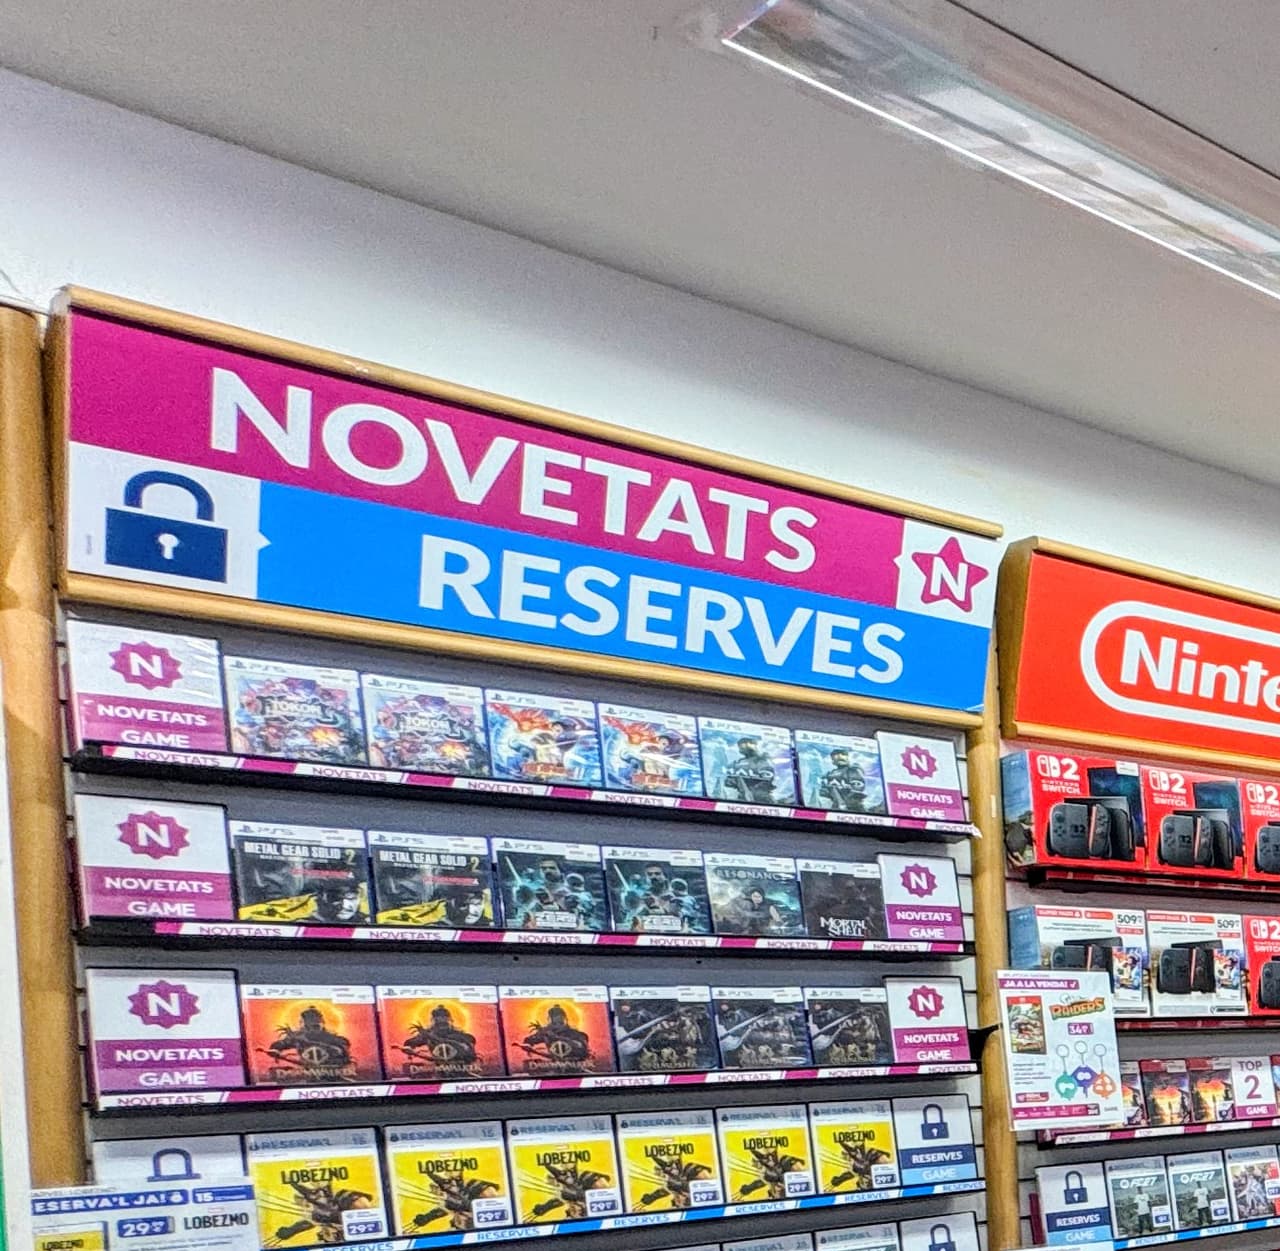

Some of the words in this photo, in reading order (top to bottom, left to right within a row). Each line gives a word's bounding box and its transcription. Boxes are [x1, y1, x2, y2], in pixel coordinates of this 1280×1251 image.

[211, 367, 818, 574] NOVETATS
[418, 534, 906, 684] RESERVES
[120, 729, 190, 747] GAME
[134, 750, 221, 766] NOVETATS
[897, 789, 953, 805] NOVETATS
[1042, 782, 1082, 796] SWITCH
[244, 841, 277, 856] METAL
[281, 844, 307, 857] GEAR
[128, 901, 196, 917] GAME
[200, 925, 282, 937] NOVETATS
[116, 1046, 224, 1063] NOVETATS
[916, 1048, 952, 1061] GAME
[1239, 1061, 1263, 1071] TOP
[138, 1069, 208, 1088] GAME
[298, 1087, 376, 1100] NOVETATS
[1244, 1075, 1262, 1099] 2
[743, 1135, 789, 1150] LOBEZNO
[911, 1149, 963, 1164] RESERVES
[280, 1165, 349, 1185] LOBEZNO
[34, 1197, 129, 1212] ESERVA'L
